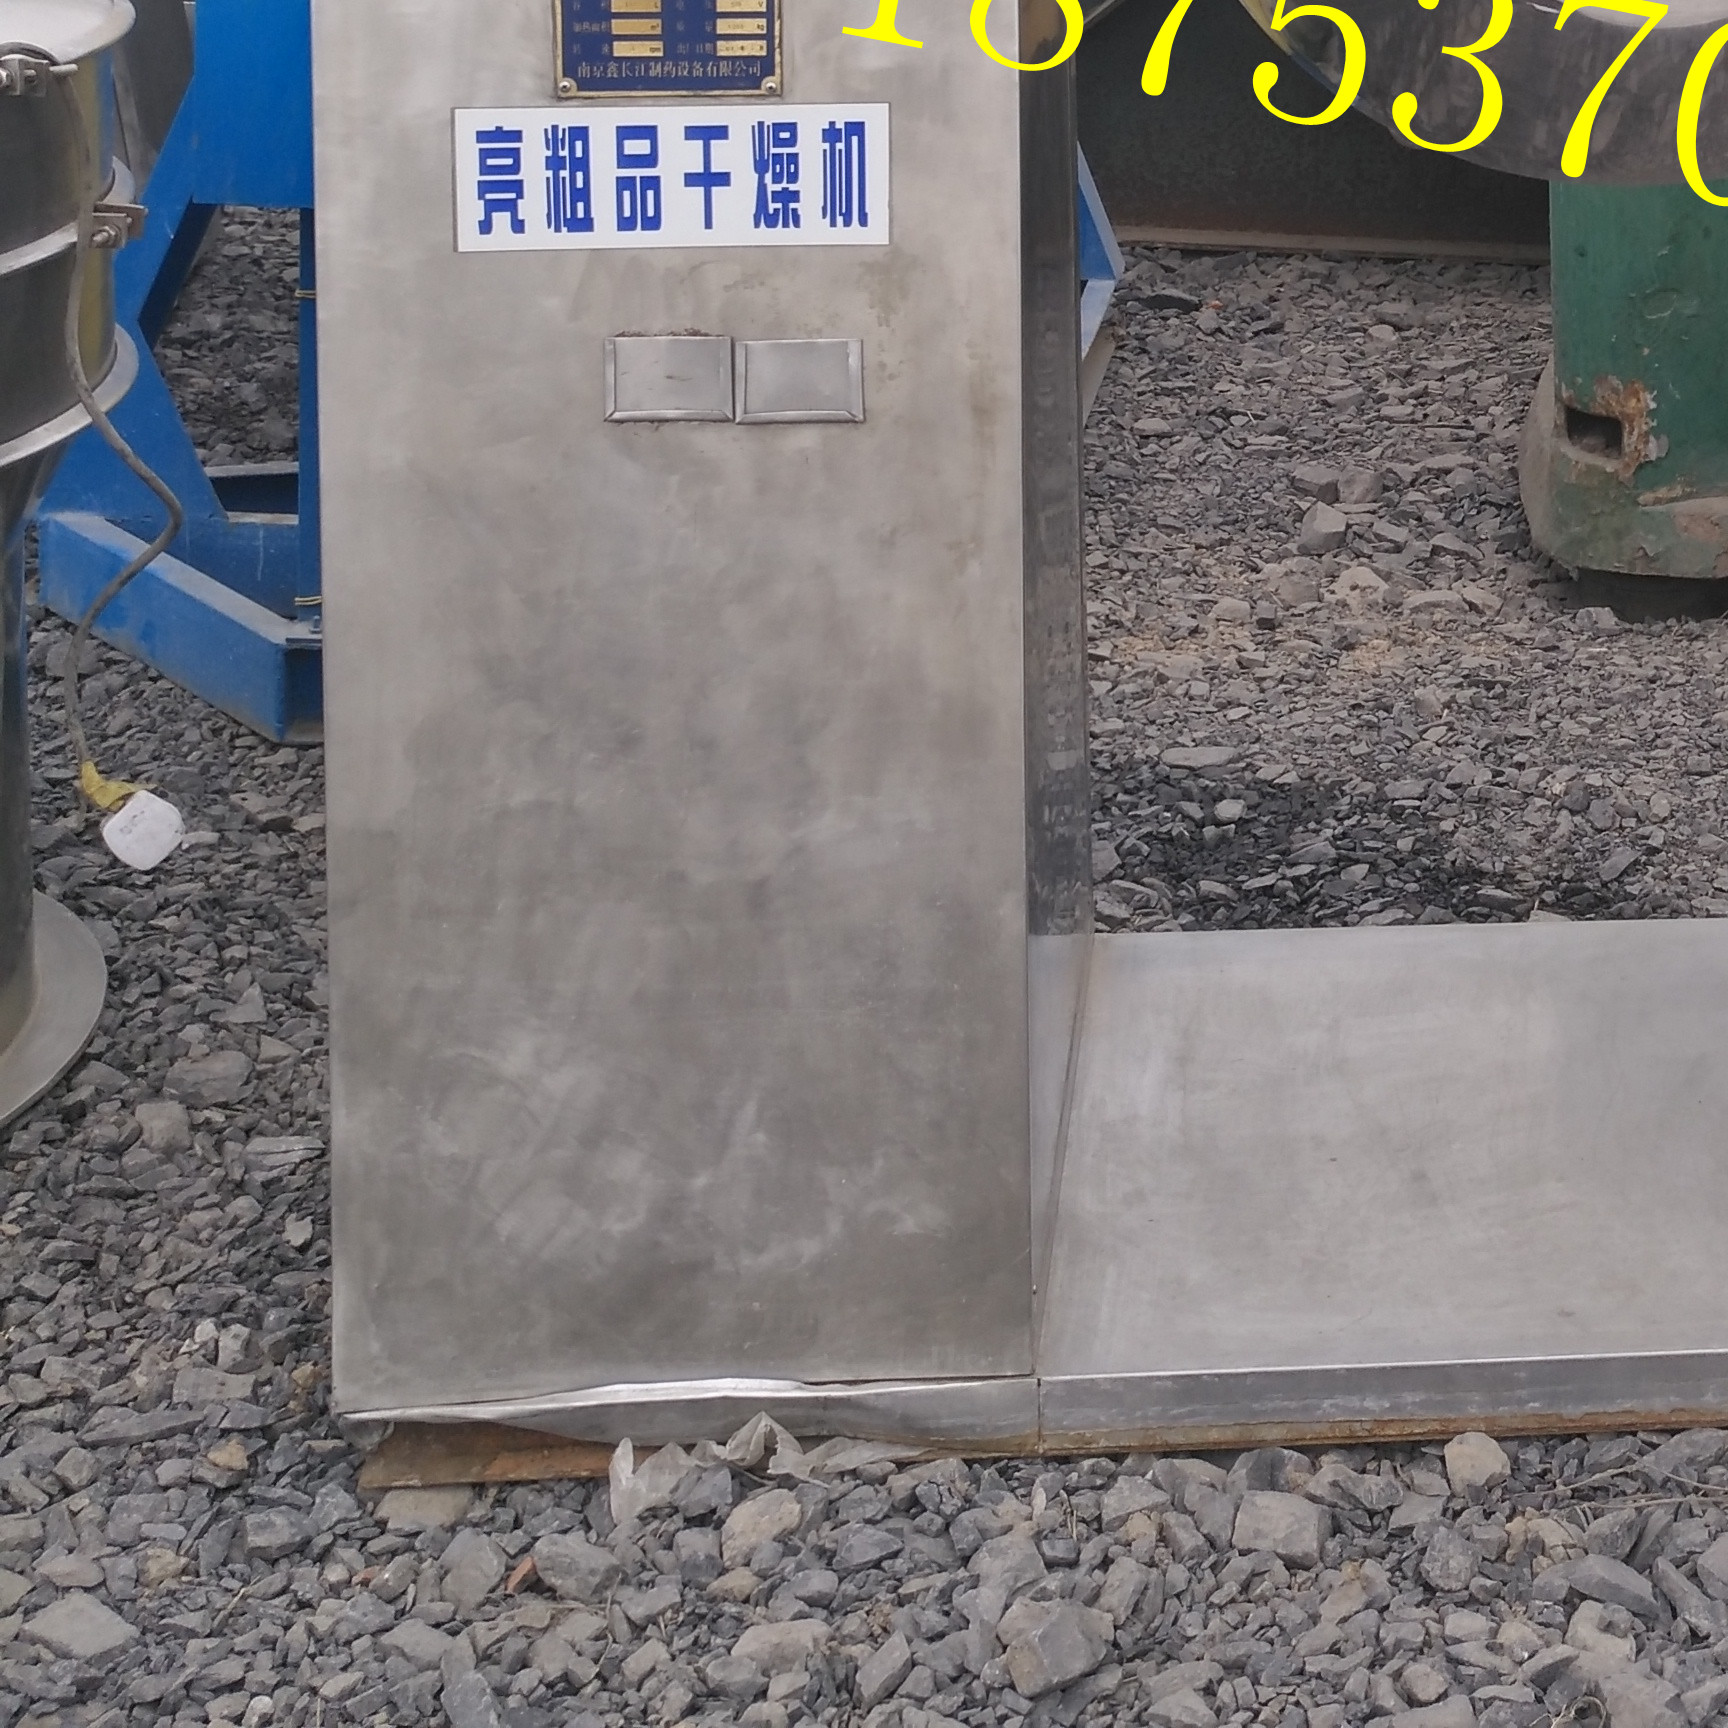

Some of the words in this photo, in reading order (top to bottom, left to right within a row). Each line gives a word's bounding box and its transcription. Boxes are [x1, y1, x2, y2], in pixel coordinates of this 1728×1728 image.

[475, 119, 870, 236] 亮粗品干燥机
